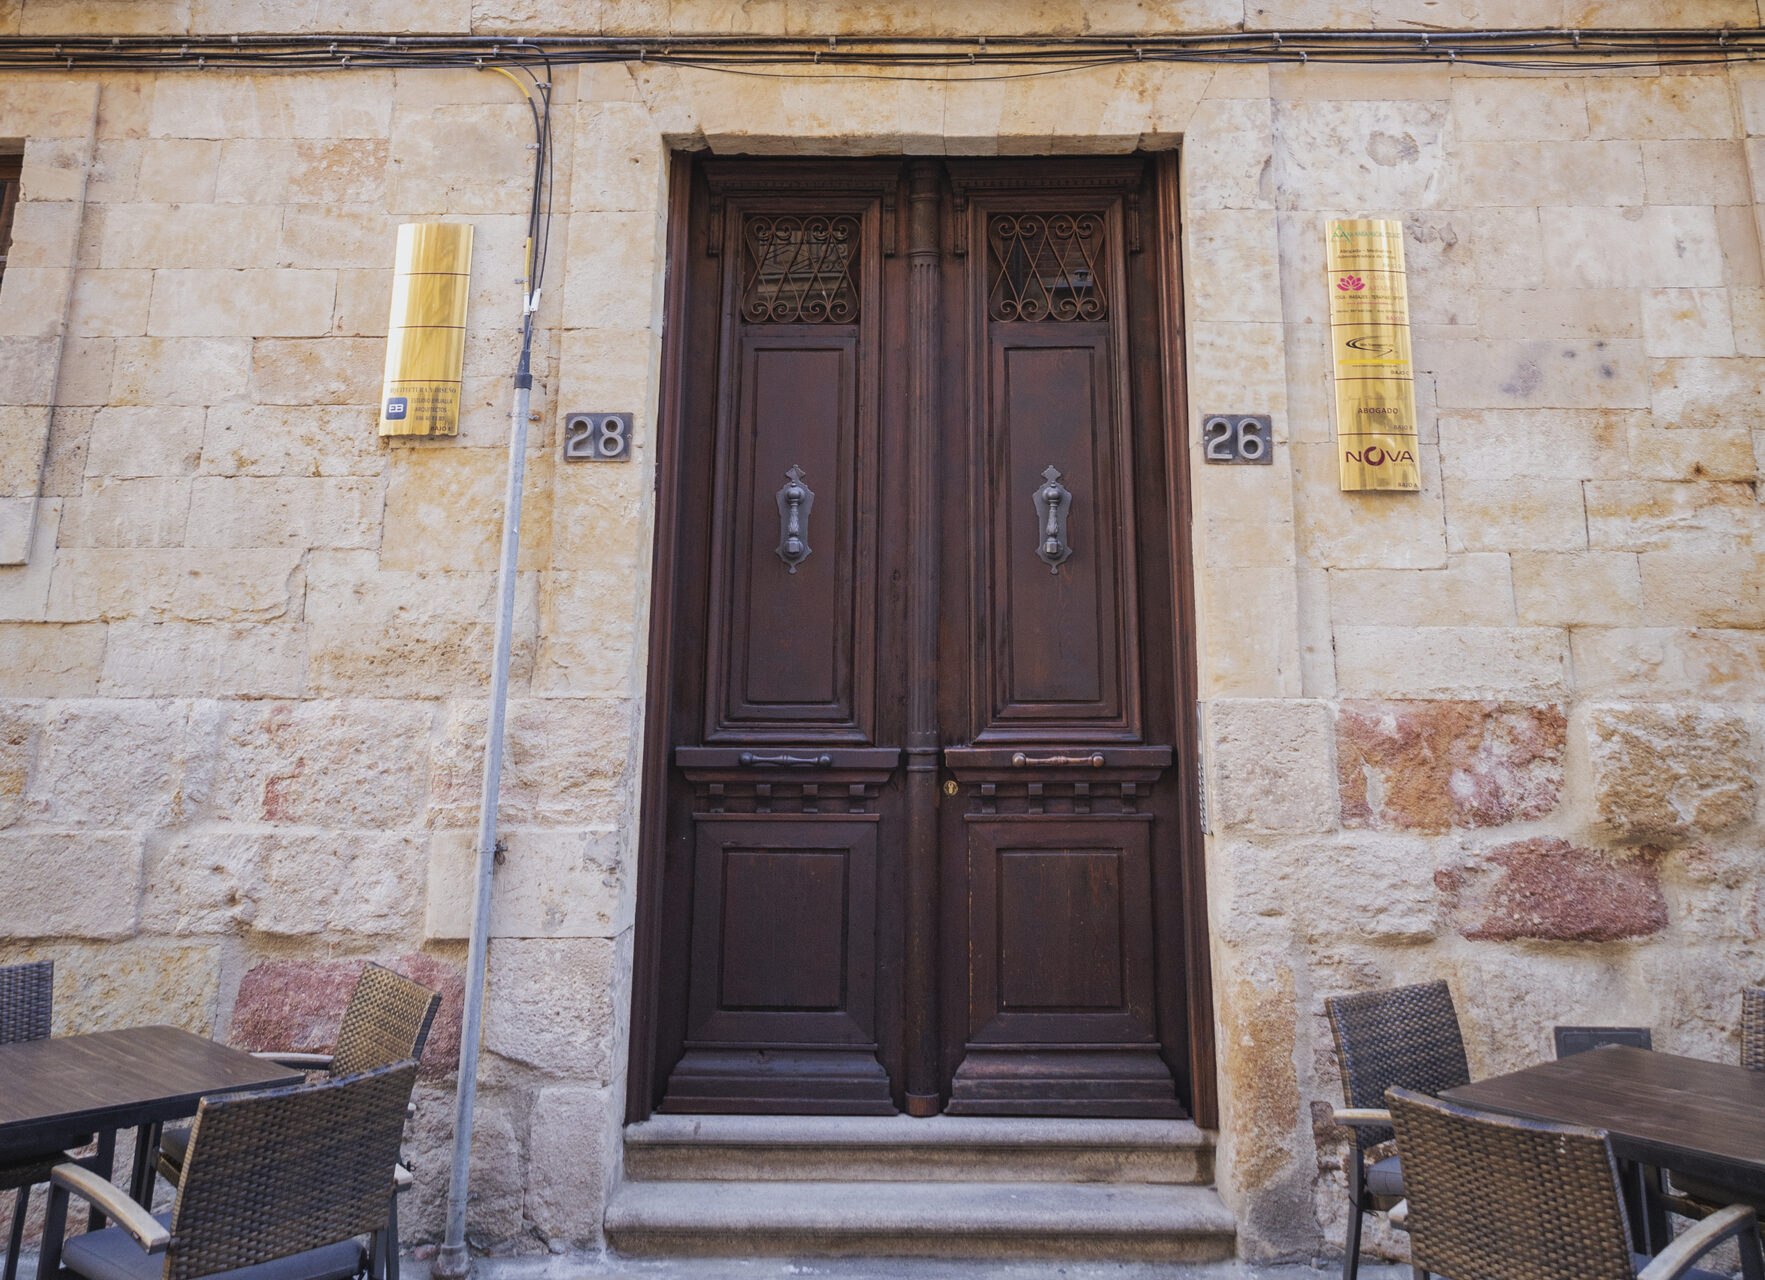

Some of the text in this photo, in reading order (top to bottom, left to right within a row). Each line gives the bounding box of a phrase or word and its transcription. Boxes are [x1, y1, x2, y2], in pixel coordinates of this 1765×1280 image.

[1357, 407, 1399, 415] ABOGADO
[566, 416, 624, 457] 28
[1206, 417, 1264, 460] 26
[1345, 446, 1415, 466] NOVA
